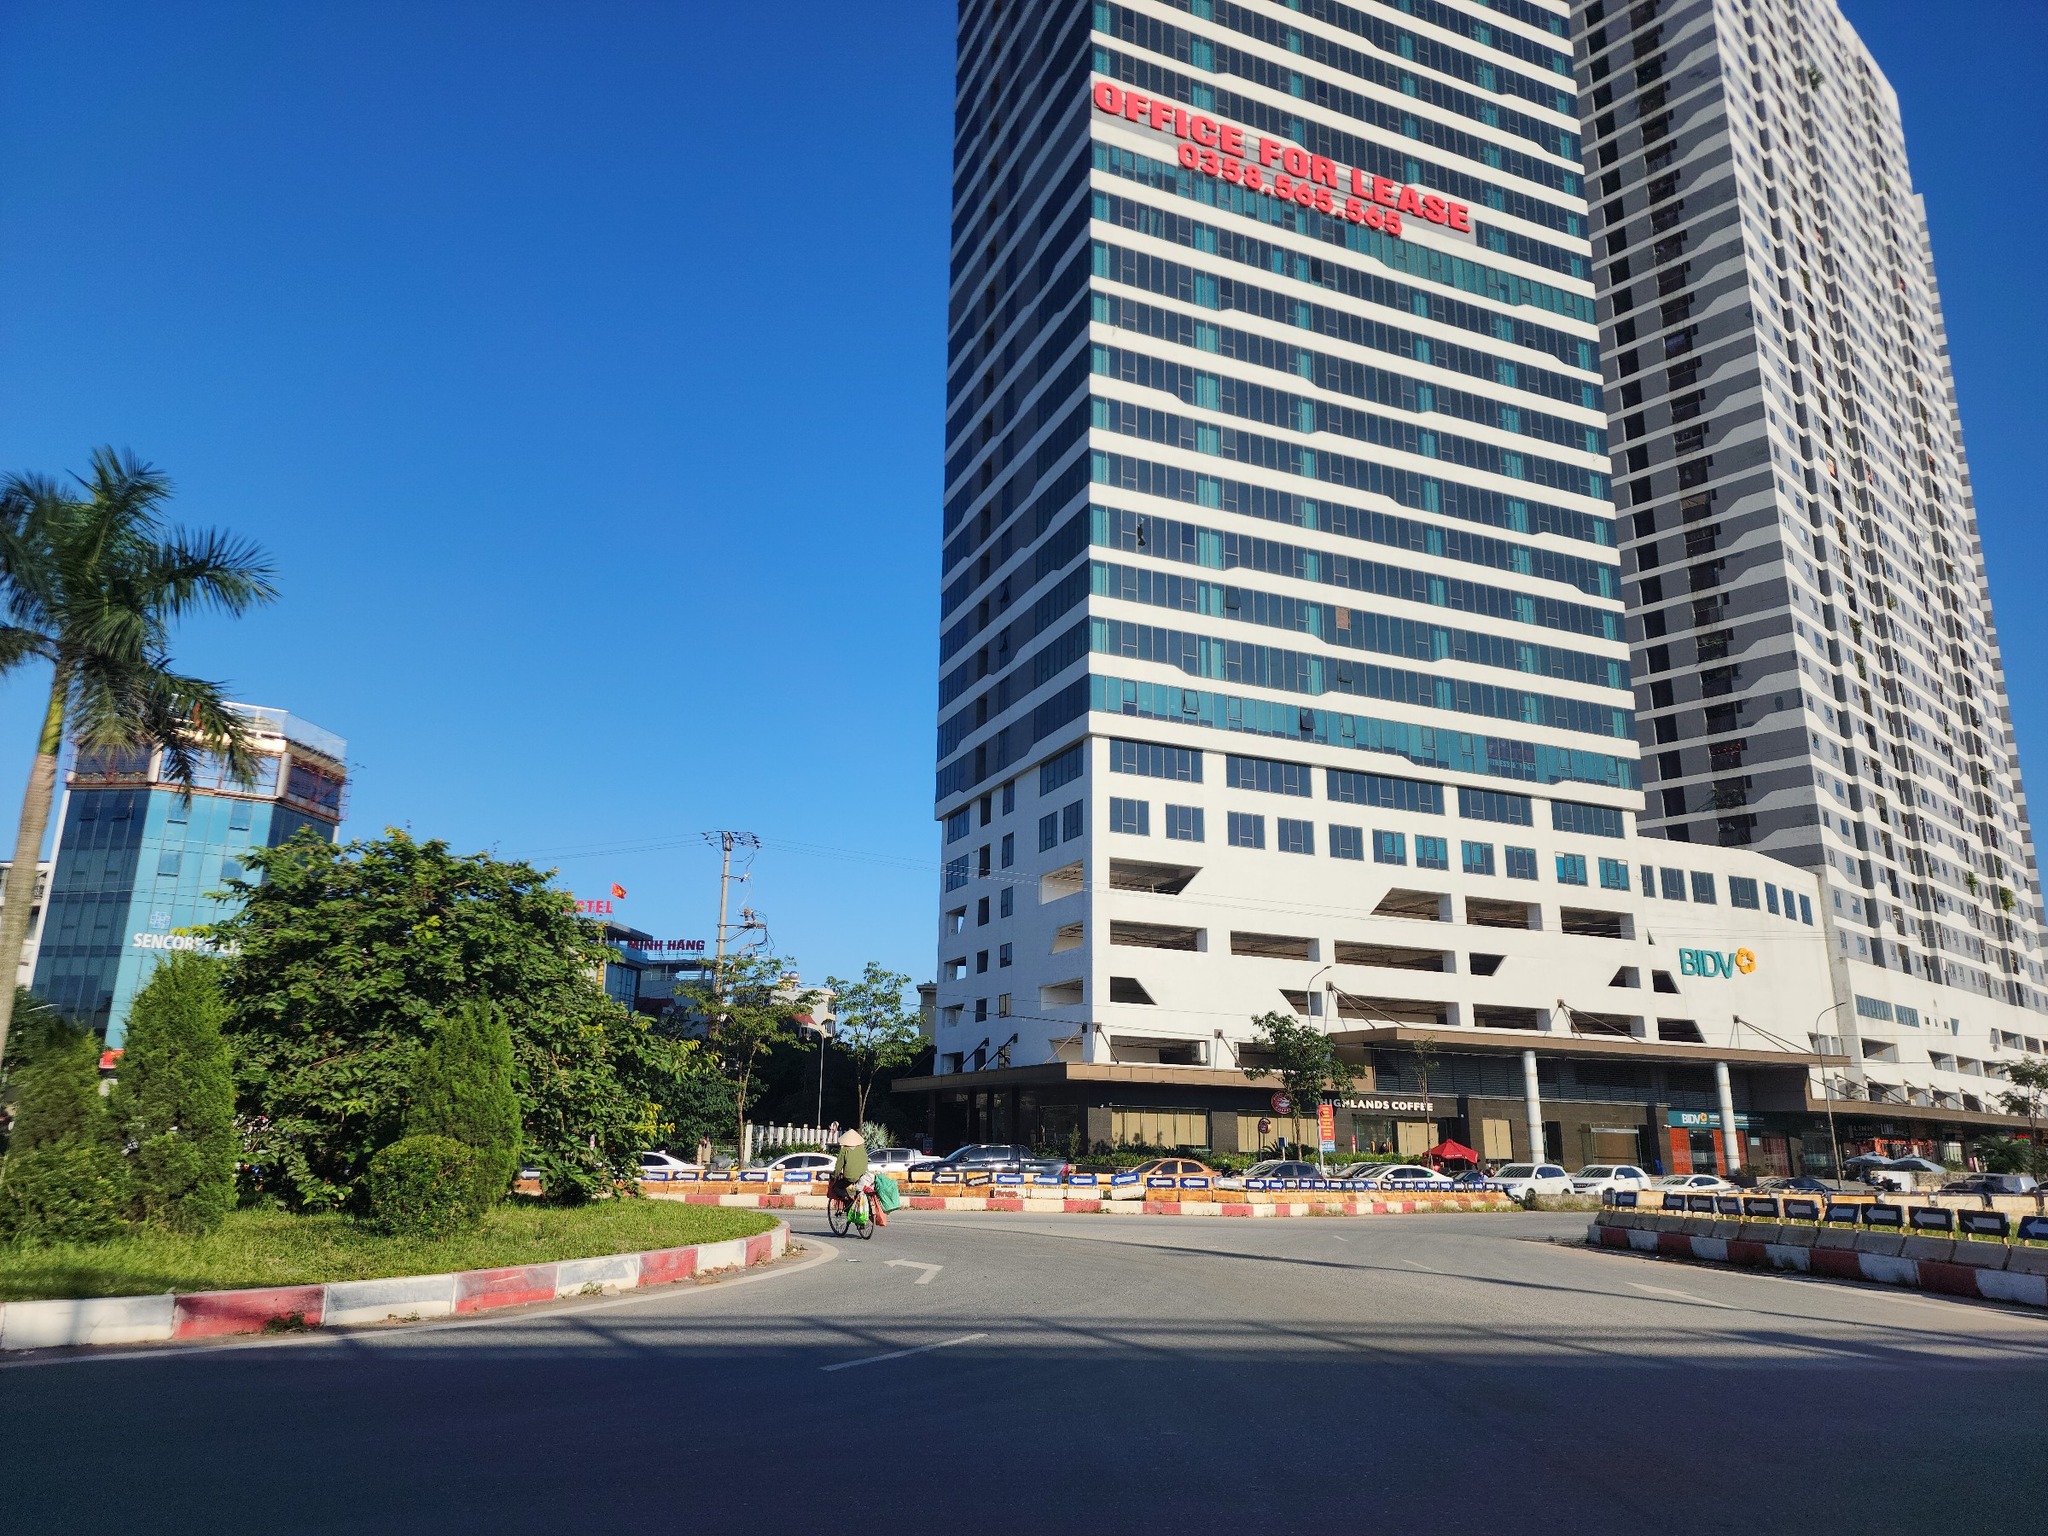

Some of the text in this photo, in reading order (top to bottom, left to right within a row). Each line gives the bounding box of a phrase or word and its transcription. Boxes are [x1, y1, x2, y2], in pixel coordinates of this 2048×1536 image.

[1093, 81, 1471, 234] OFFICE FOR LEASE
[1177, 142, 1403, 236] 0358.565.565
[565, 899, 613, 914] OTEL
[1679, 948, 1736, 979] BIDV
[1391, 1101, 1434, 1111] COFFEE
[1681, 1113, 1701, 1125] BIDV
